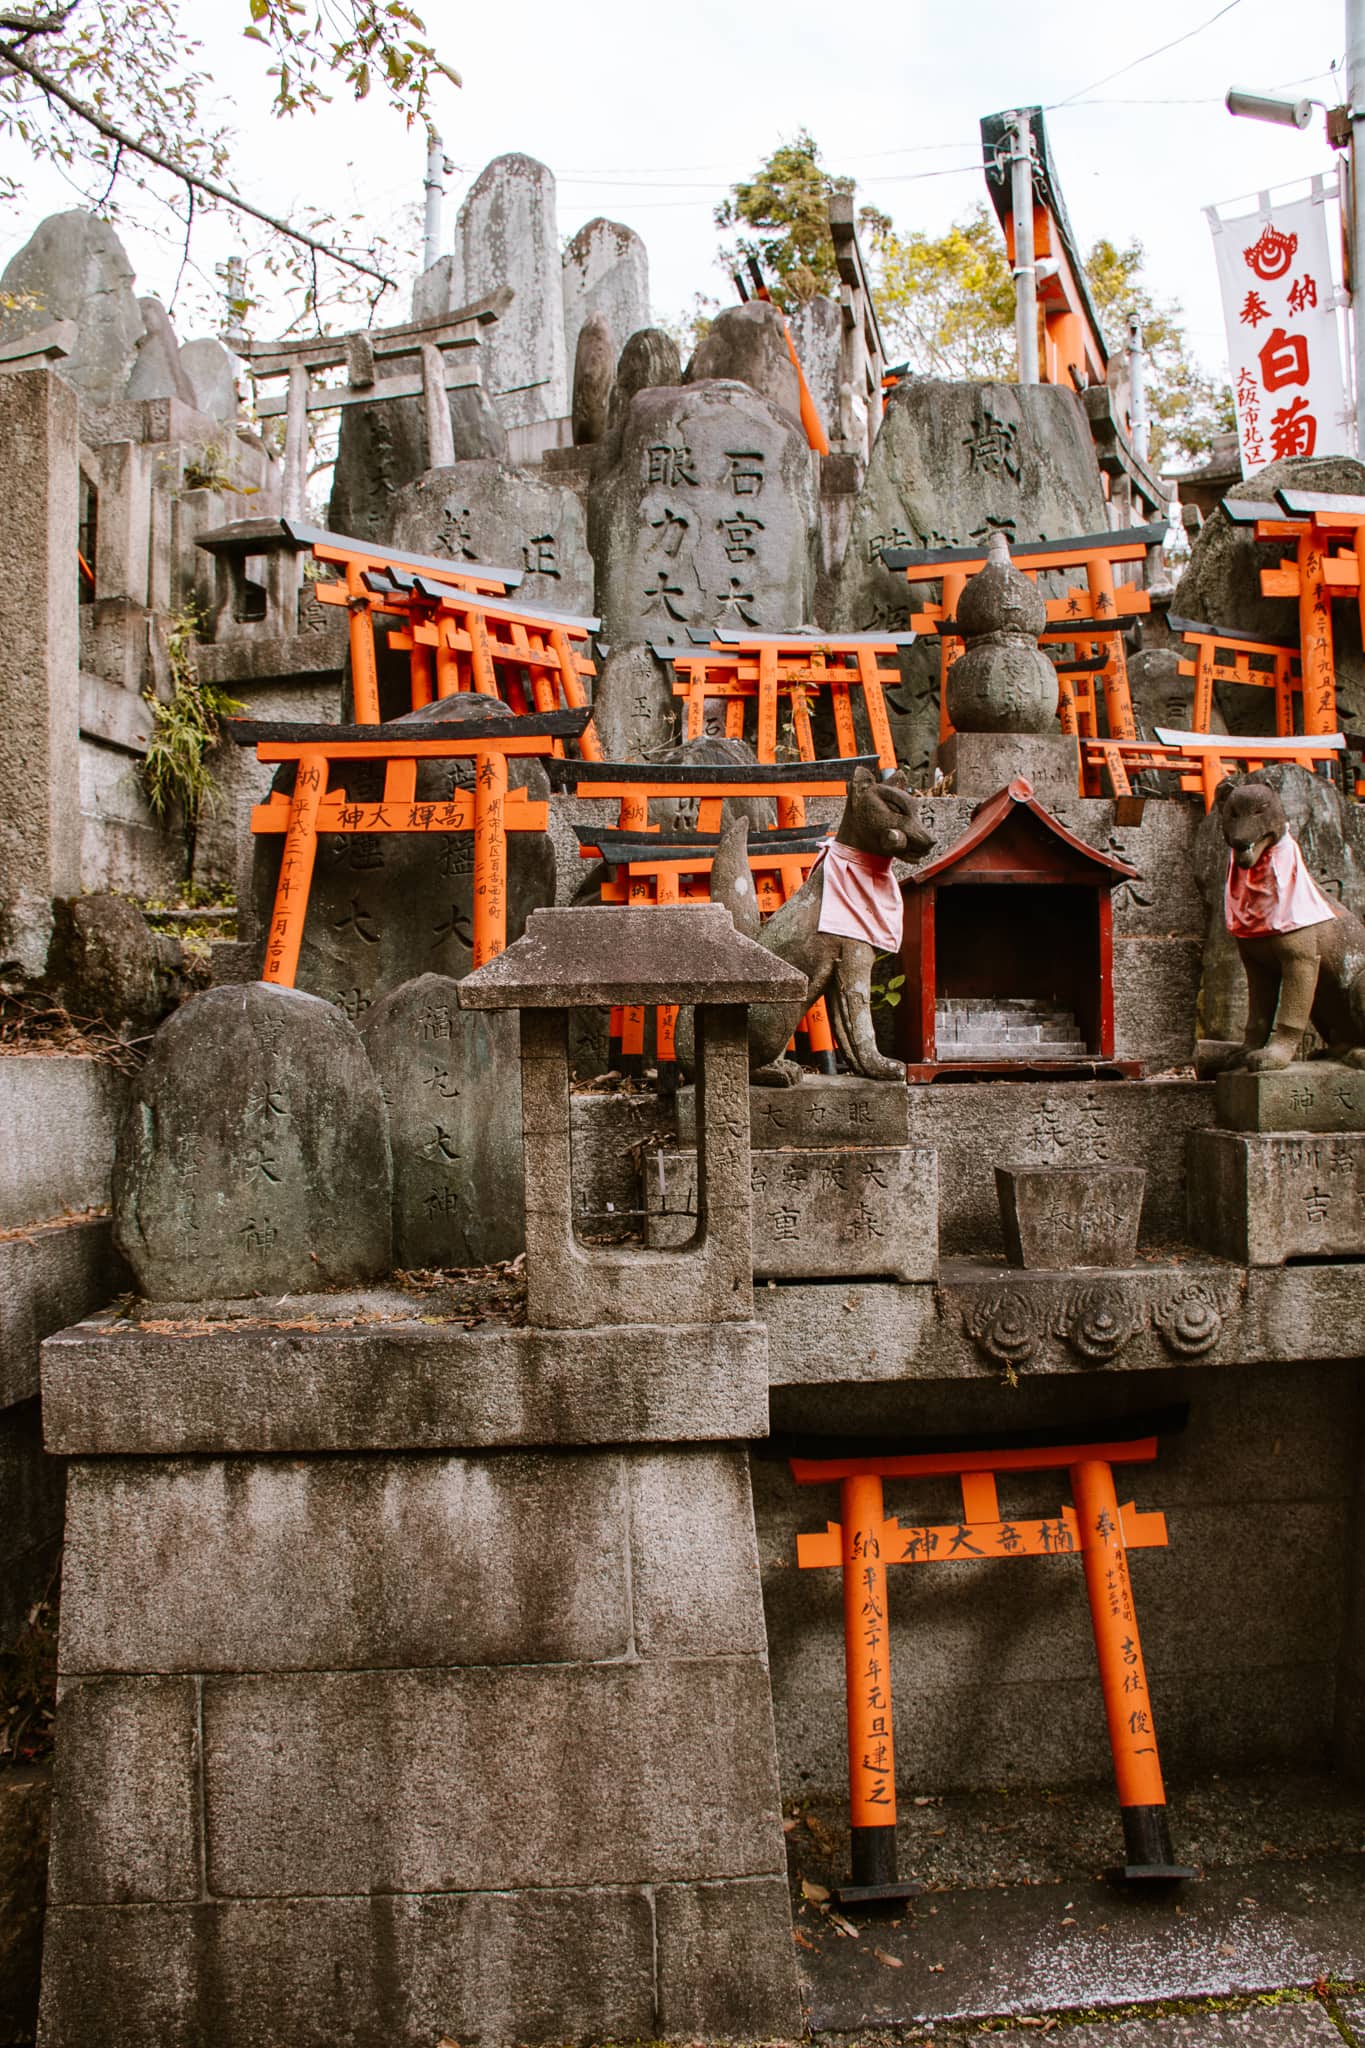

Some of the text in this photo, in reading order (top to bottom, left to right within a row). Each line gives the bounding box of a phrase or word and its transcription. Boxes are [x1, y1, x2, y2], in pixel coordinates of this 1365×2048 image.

[1236, 367, 1266, 466] 大阪市北区
[1257, 327, 1318, 464] 白菊
[640, 445, 699, 645] 眼力大
[851, 1530, 881, 1562] 納
